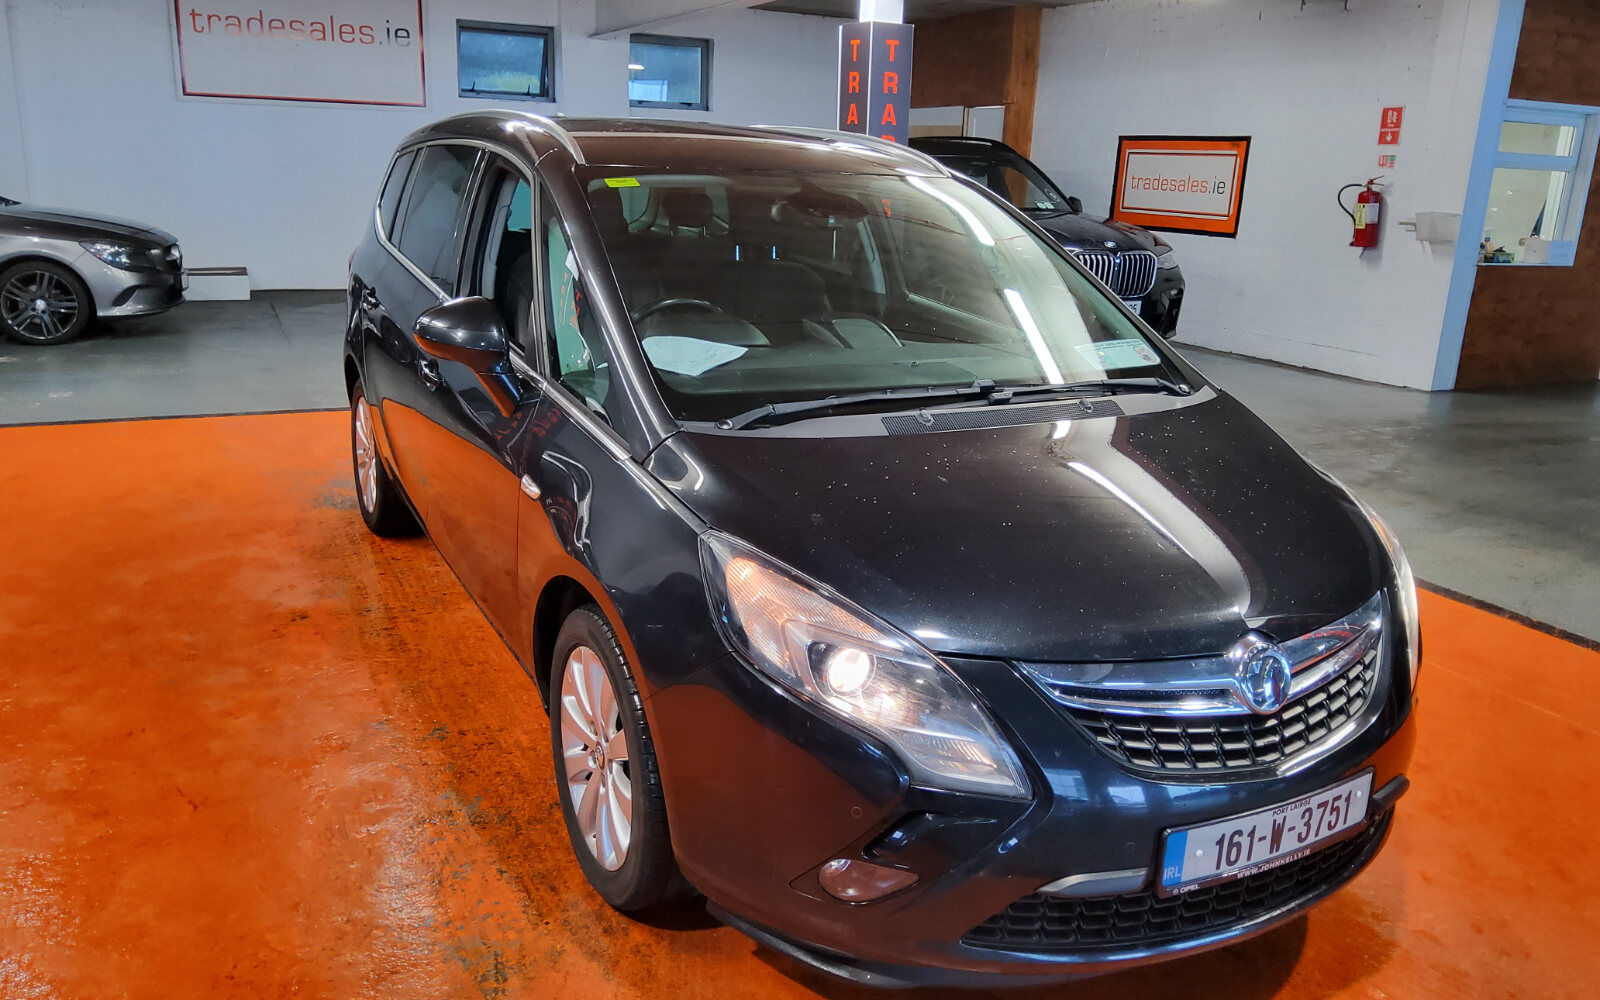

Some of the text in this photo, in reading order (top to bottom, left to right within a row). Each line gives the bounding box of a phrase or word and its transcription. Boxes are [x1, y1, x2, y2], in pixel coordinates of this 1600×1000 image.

[189, 8, 410, 47] tradesales.ie
[1131, 173, 1226, 195] tradesales.ie
[1272, 806, 1289, 817] PORT
[1215, 789, 1353, 871] 161-W-3751
[1163, 865, 1181, 881] IRL
[1237, 848, 1311, 879] WWW.JOHNKELLY.IE
[1180, 884, 1200, 894] OPEL
